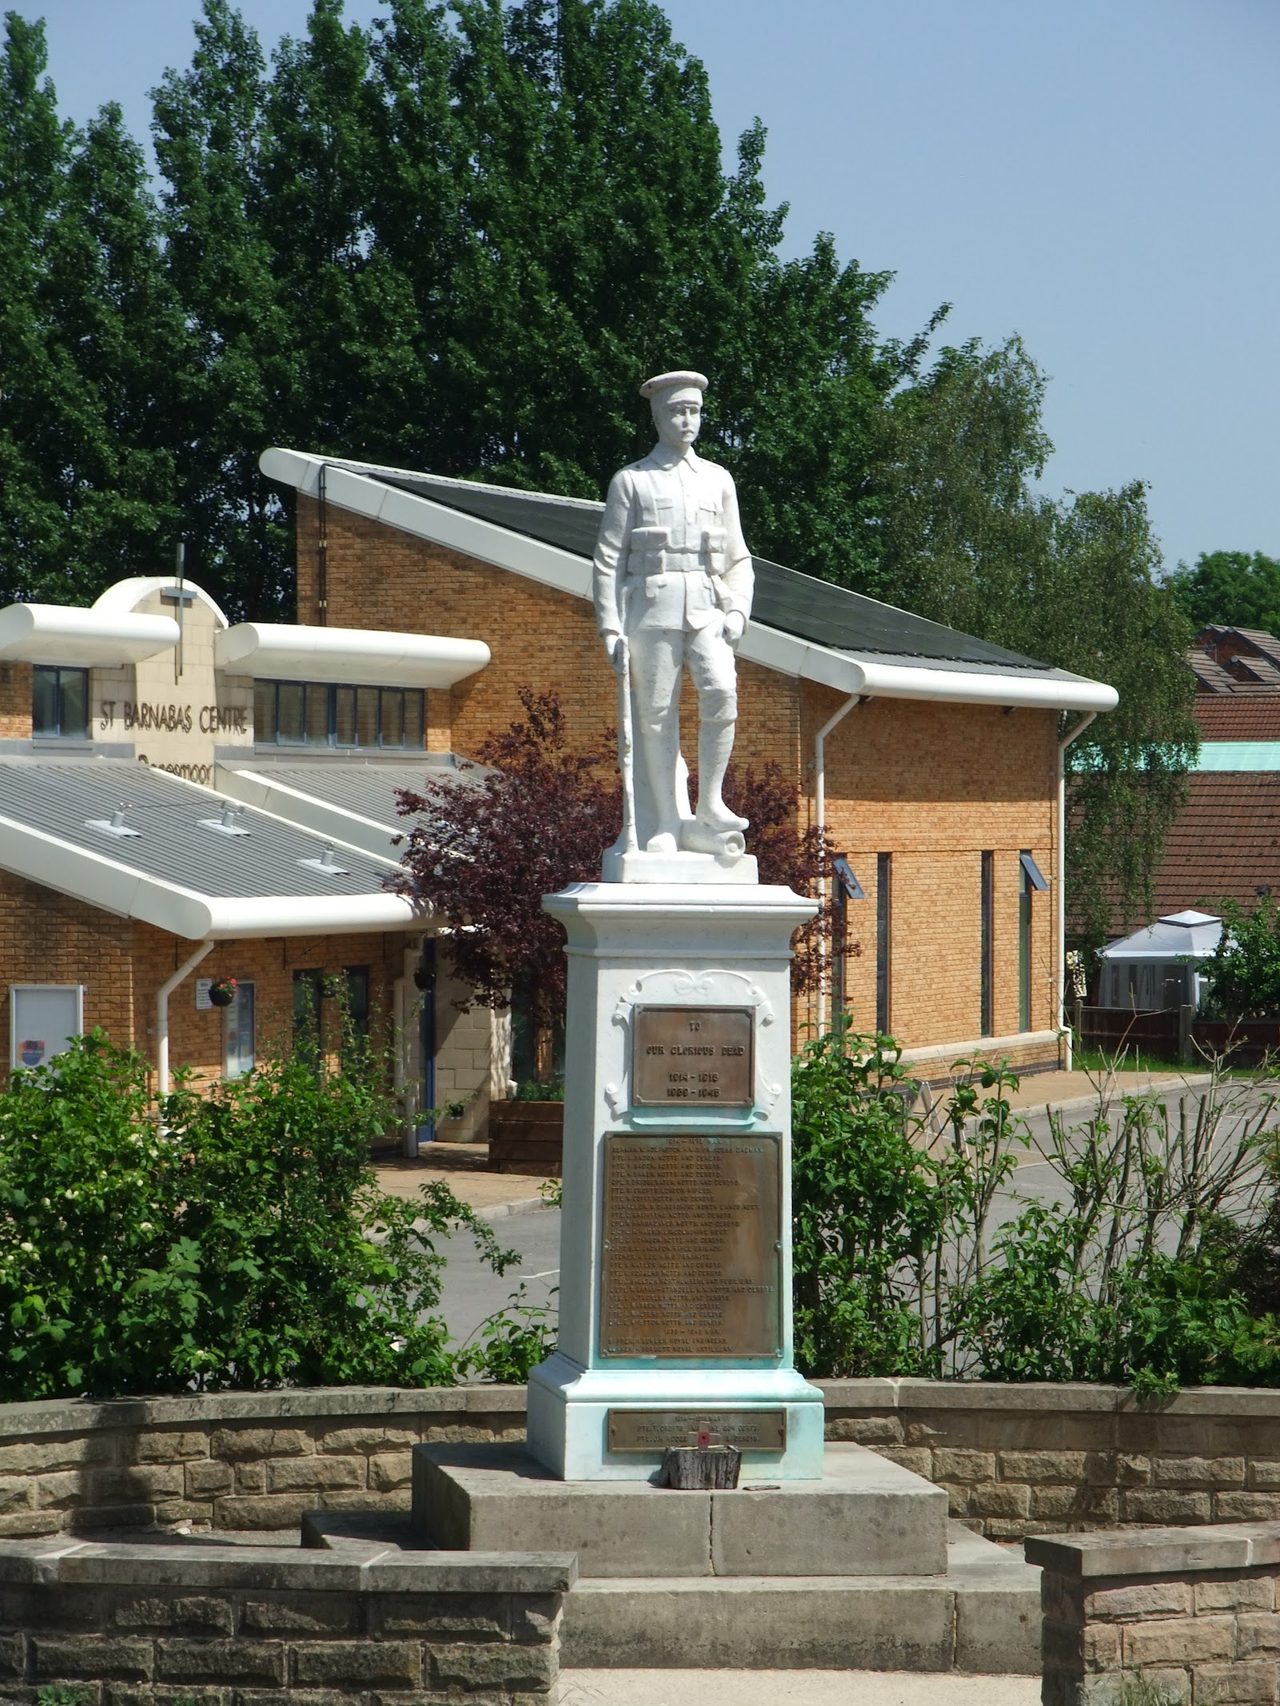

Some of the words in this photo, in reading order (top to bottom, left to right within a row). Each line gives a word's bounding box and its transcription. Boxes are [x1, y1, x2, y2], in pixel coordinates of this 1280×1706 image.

[100, 701, 116, 730] ST
[124, 702, 193, 733] BARNABAS
[199, 705, 248, 735] CENTRE
[689, 1021, 701, 1031] TO
[645, 1045, 664, 1056] OUR
[670, 1045, 714, 1056] GLORIOUS
[721, 1045, 745, 1056] DEAD
